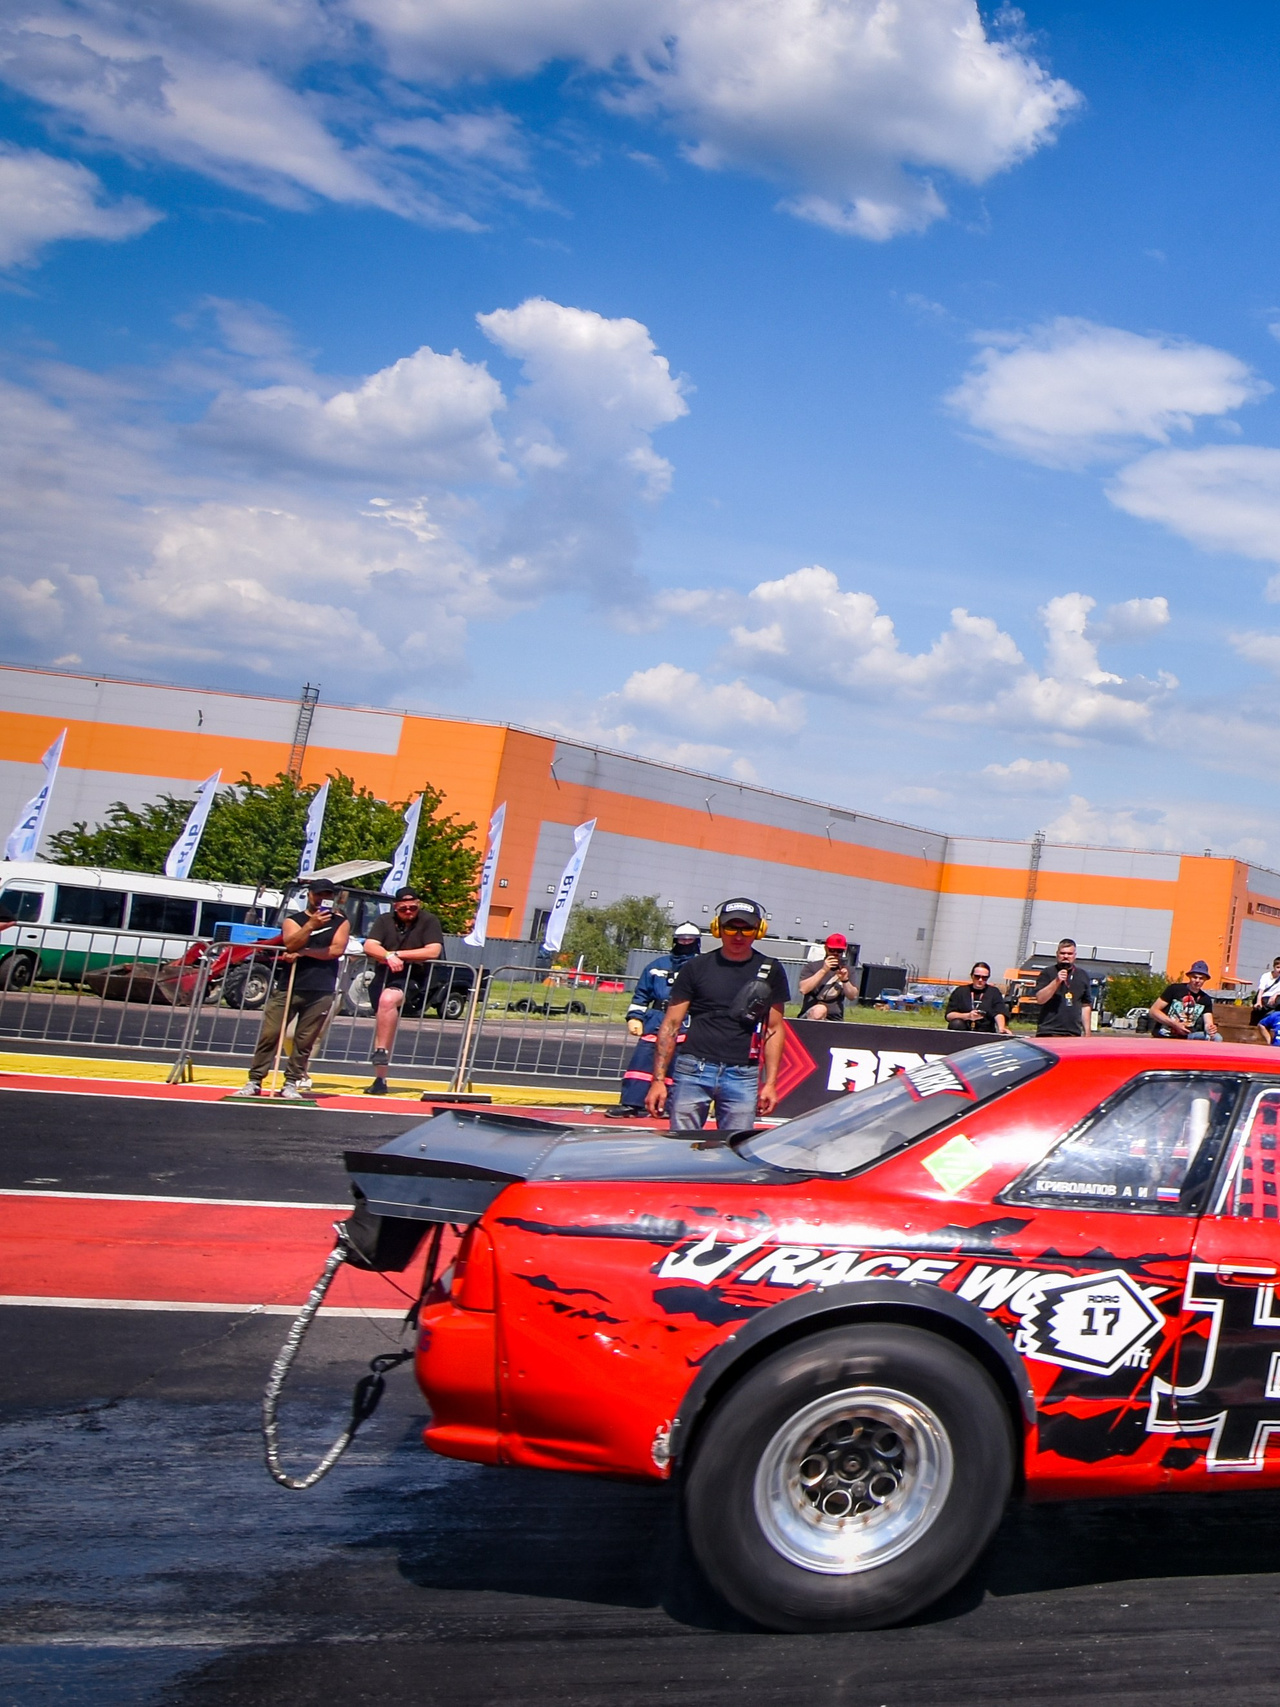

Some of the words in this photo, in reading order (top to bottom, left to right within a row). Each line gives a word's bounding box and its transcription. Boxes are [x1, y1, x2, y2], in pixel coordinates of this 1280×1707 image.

[555, 875, 574, 910] ВТБ
[1036, 1180, 1117, 1196] КРИВОЛАПОВ
[1122, 1186, 1132, 1197] А
[1138, 1187, 1148, 1198] И
[1080, 1307, 1121, 1336] 17
